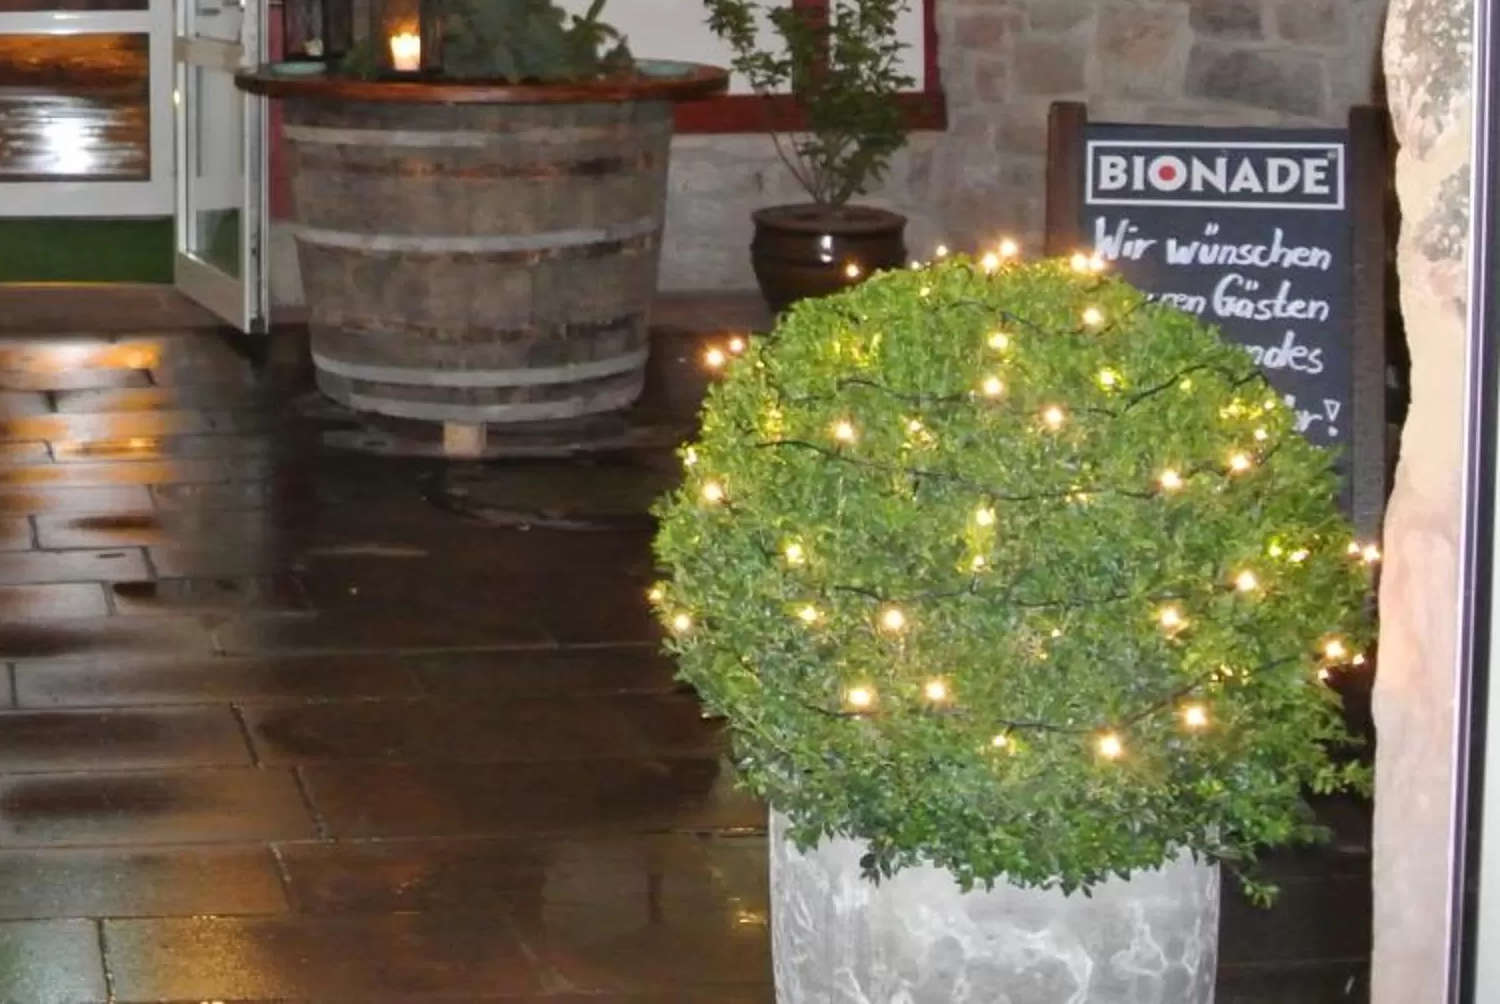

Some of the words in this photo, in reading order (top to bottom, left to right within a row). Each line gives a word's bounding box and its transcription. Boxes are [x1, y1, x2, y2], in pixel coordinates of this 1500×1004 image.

[1098, 155, 1330, 195] BIONADE
[1093, 216, 1157, 261] Wir
[1166, 222, 1332, 270] wünschen
[1213, 273, 1329, 321] Gästen
